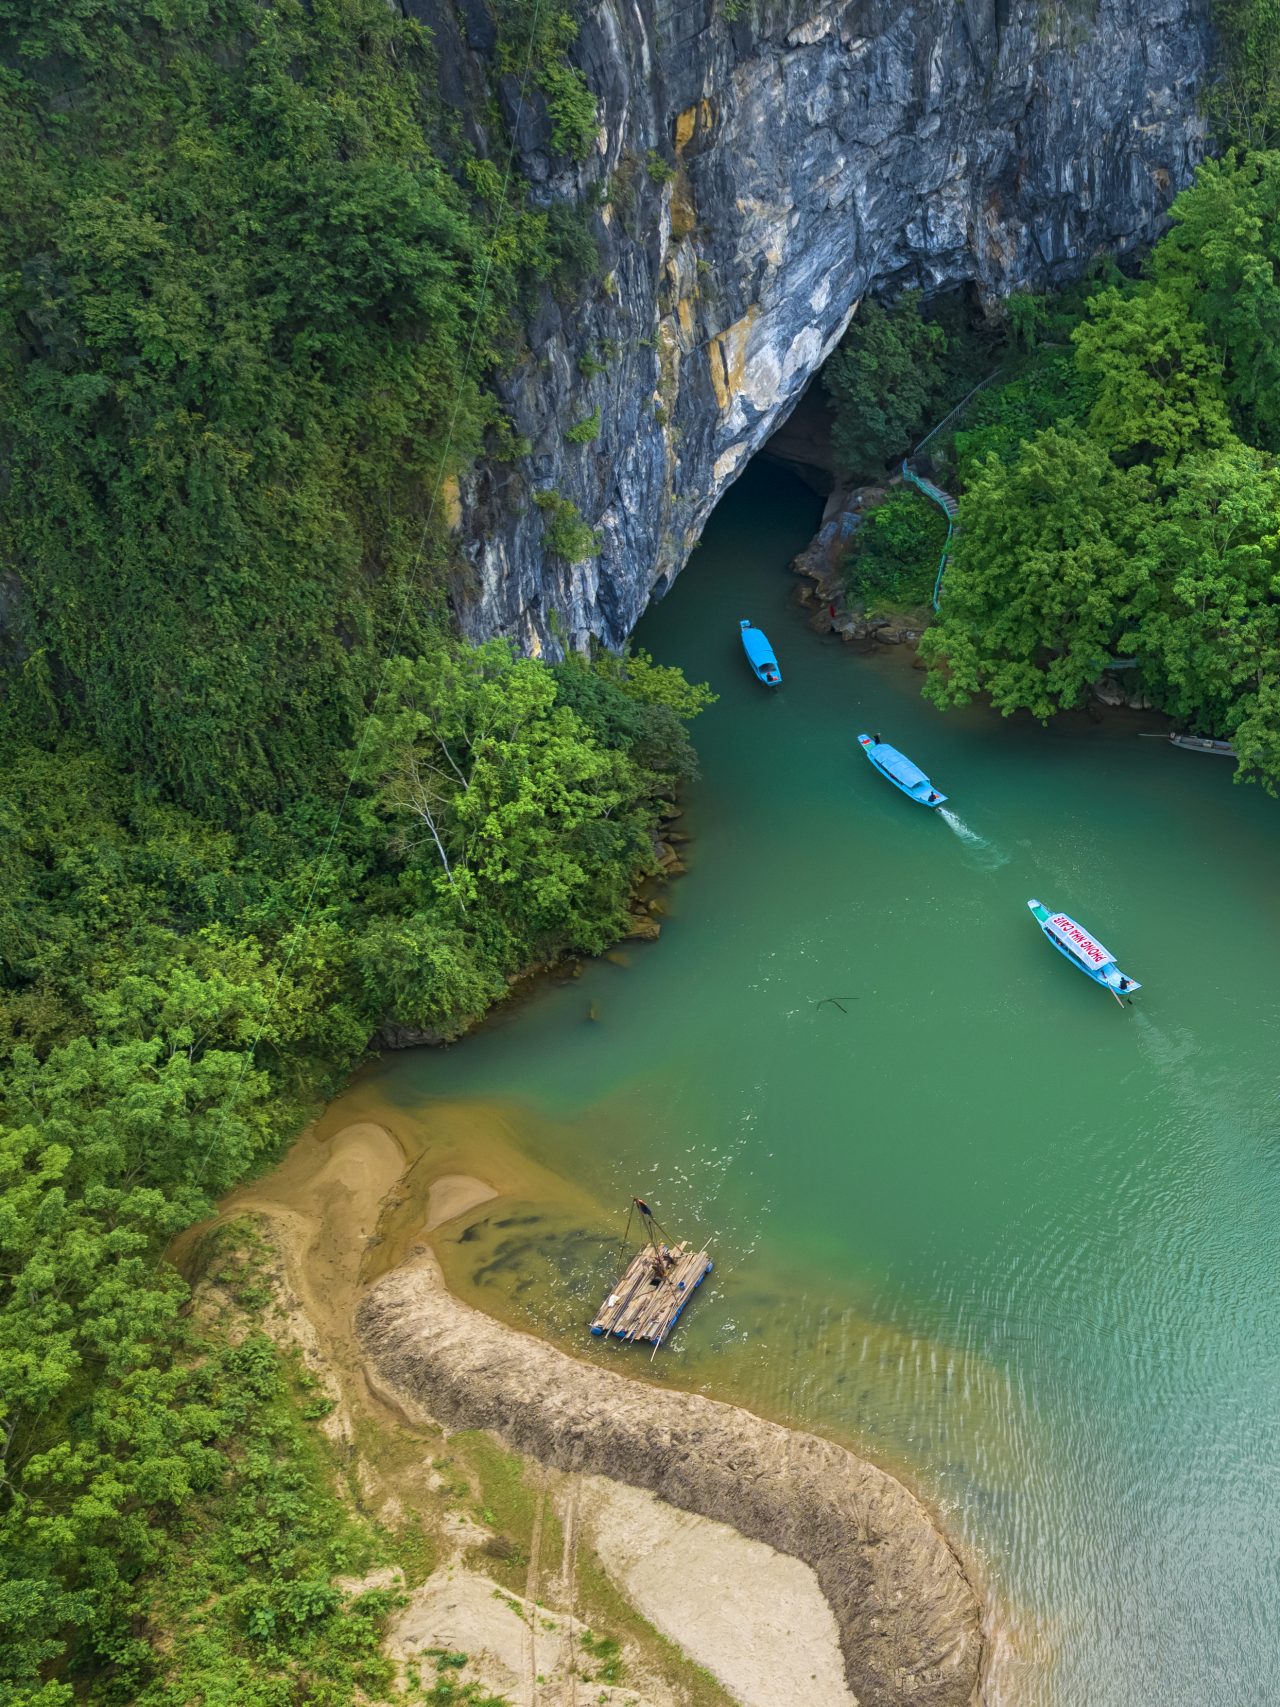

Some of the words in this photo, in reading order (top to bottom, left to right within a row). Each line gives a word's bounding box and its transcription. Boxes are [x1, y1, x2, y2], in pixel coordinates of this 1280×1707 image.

[1053, 917, 1074, 931] CAVE
[1068, 929, 1087, 943] NHA
[1080, 941, 1107, 963] PHONG
